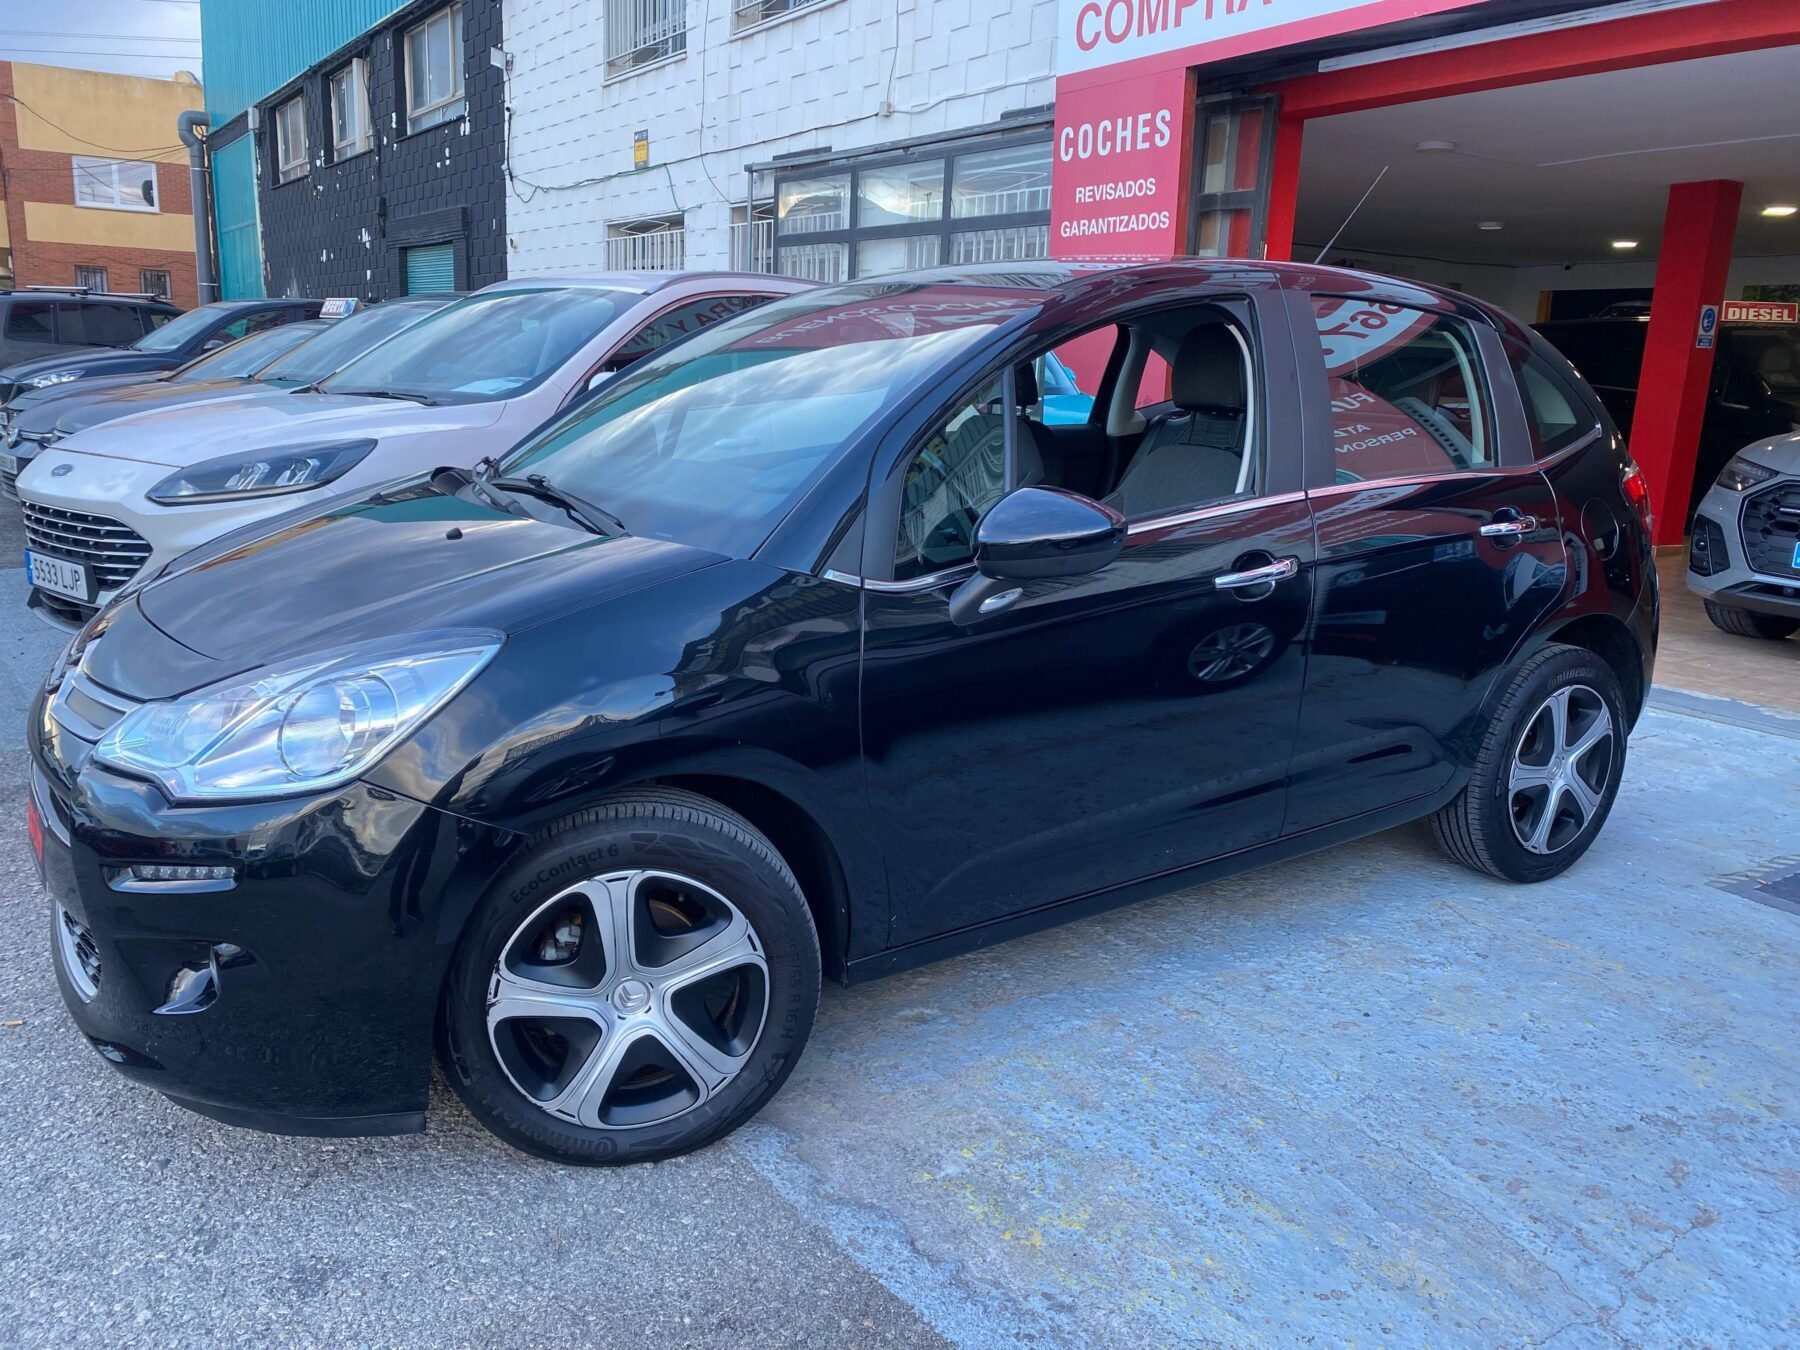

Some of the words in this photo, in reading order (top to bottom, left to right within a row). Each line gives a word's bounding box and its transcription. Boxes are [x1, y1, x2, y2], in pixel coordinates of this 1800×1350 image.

[1060, 109, 1171, 162] COCHES
[1075, 177, 1156, 204] REVISADOS
[1060, 210, 1170, 238] GARANTIZADOS
[1727, 307, 1793, 321] DIESEL
[33, 558, 58, 586] 5533
[60, 565, 81, 592] LJP
[509, 846, 605, 905] EcoContact
[607, 843, 620, 857] 6
